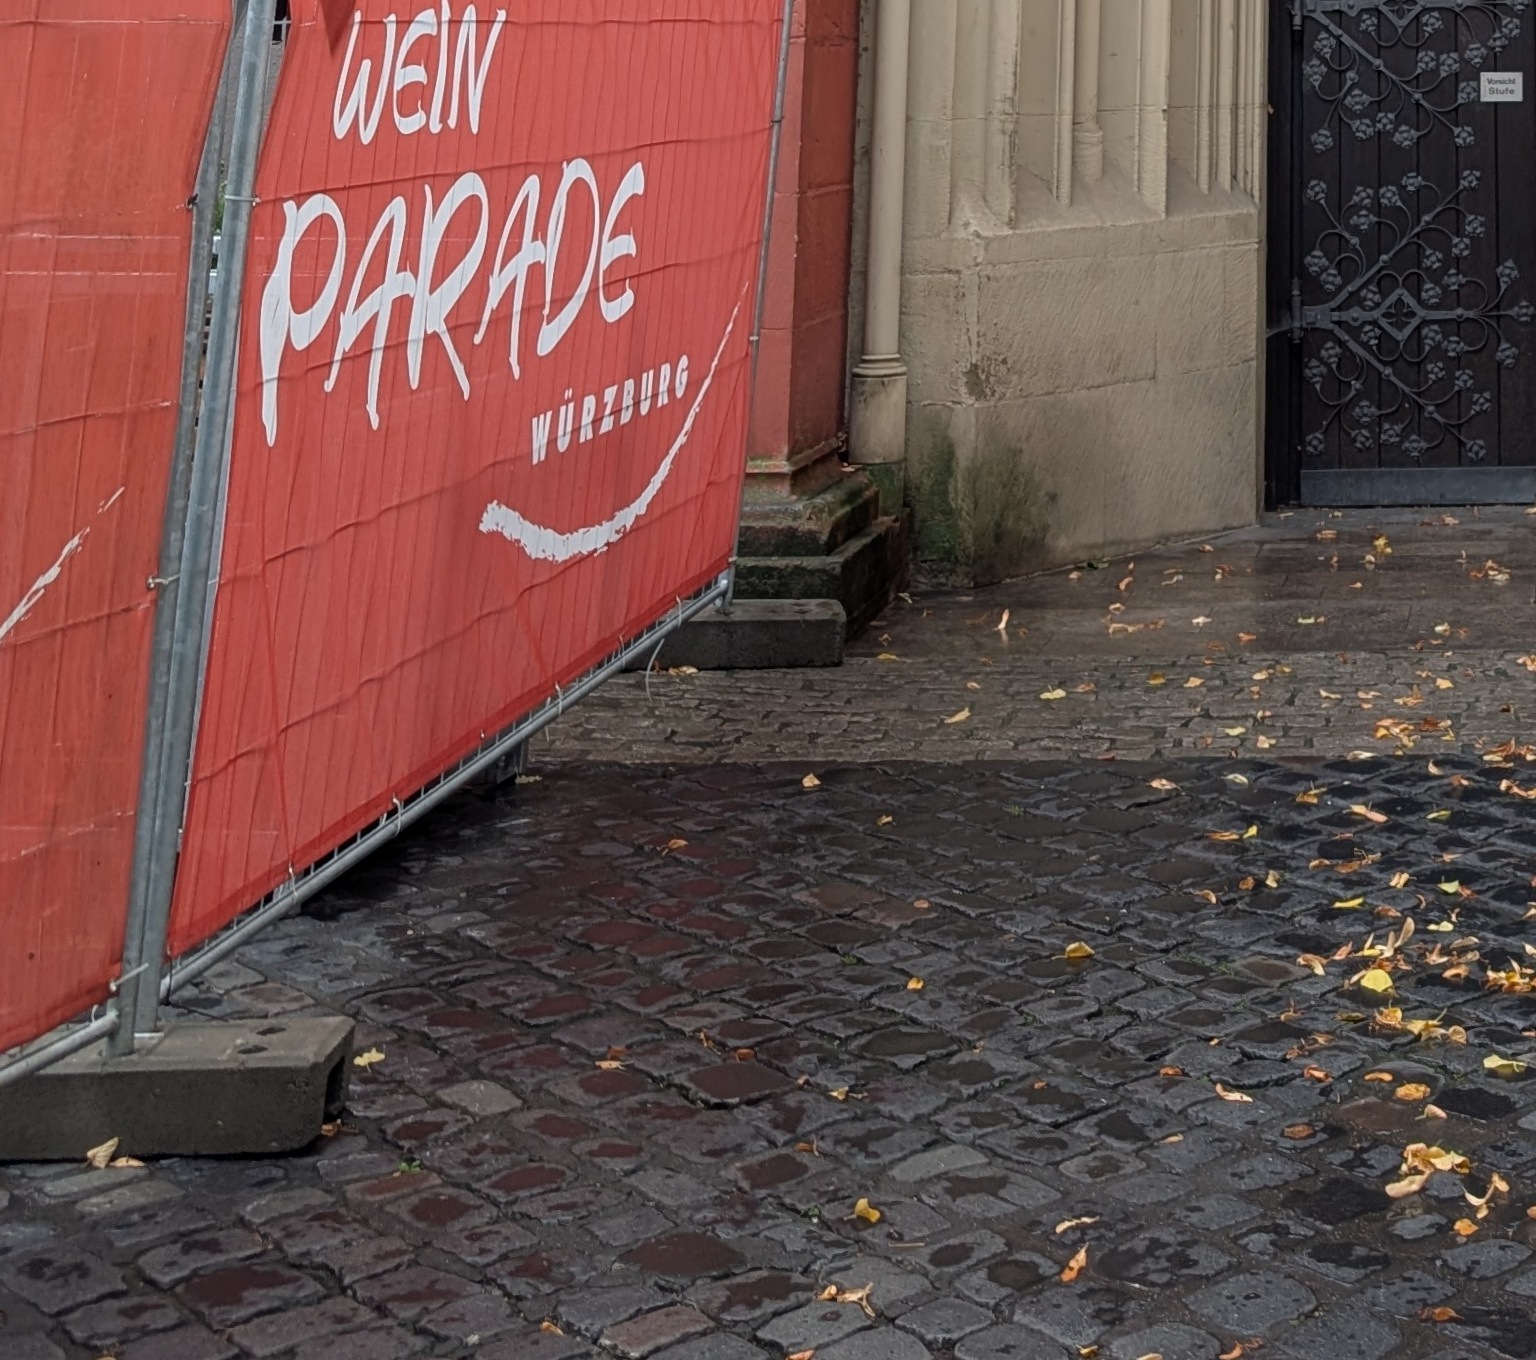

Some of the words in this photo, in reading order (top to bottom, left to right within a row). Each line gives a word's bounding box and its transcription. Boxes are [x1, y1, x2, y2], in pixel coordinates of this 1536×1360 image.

[1486, 77, 1516, 85] Vorsicht
[1488, 87, 1515, 95] Stufe
[260, 157, 645, 447] PARADE
[531, 353, 690, 465] WÜRZBURG
